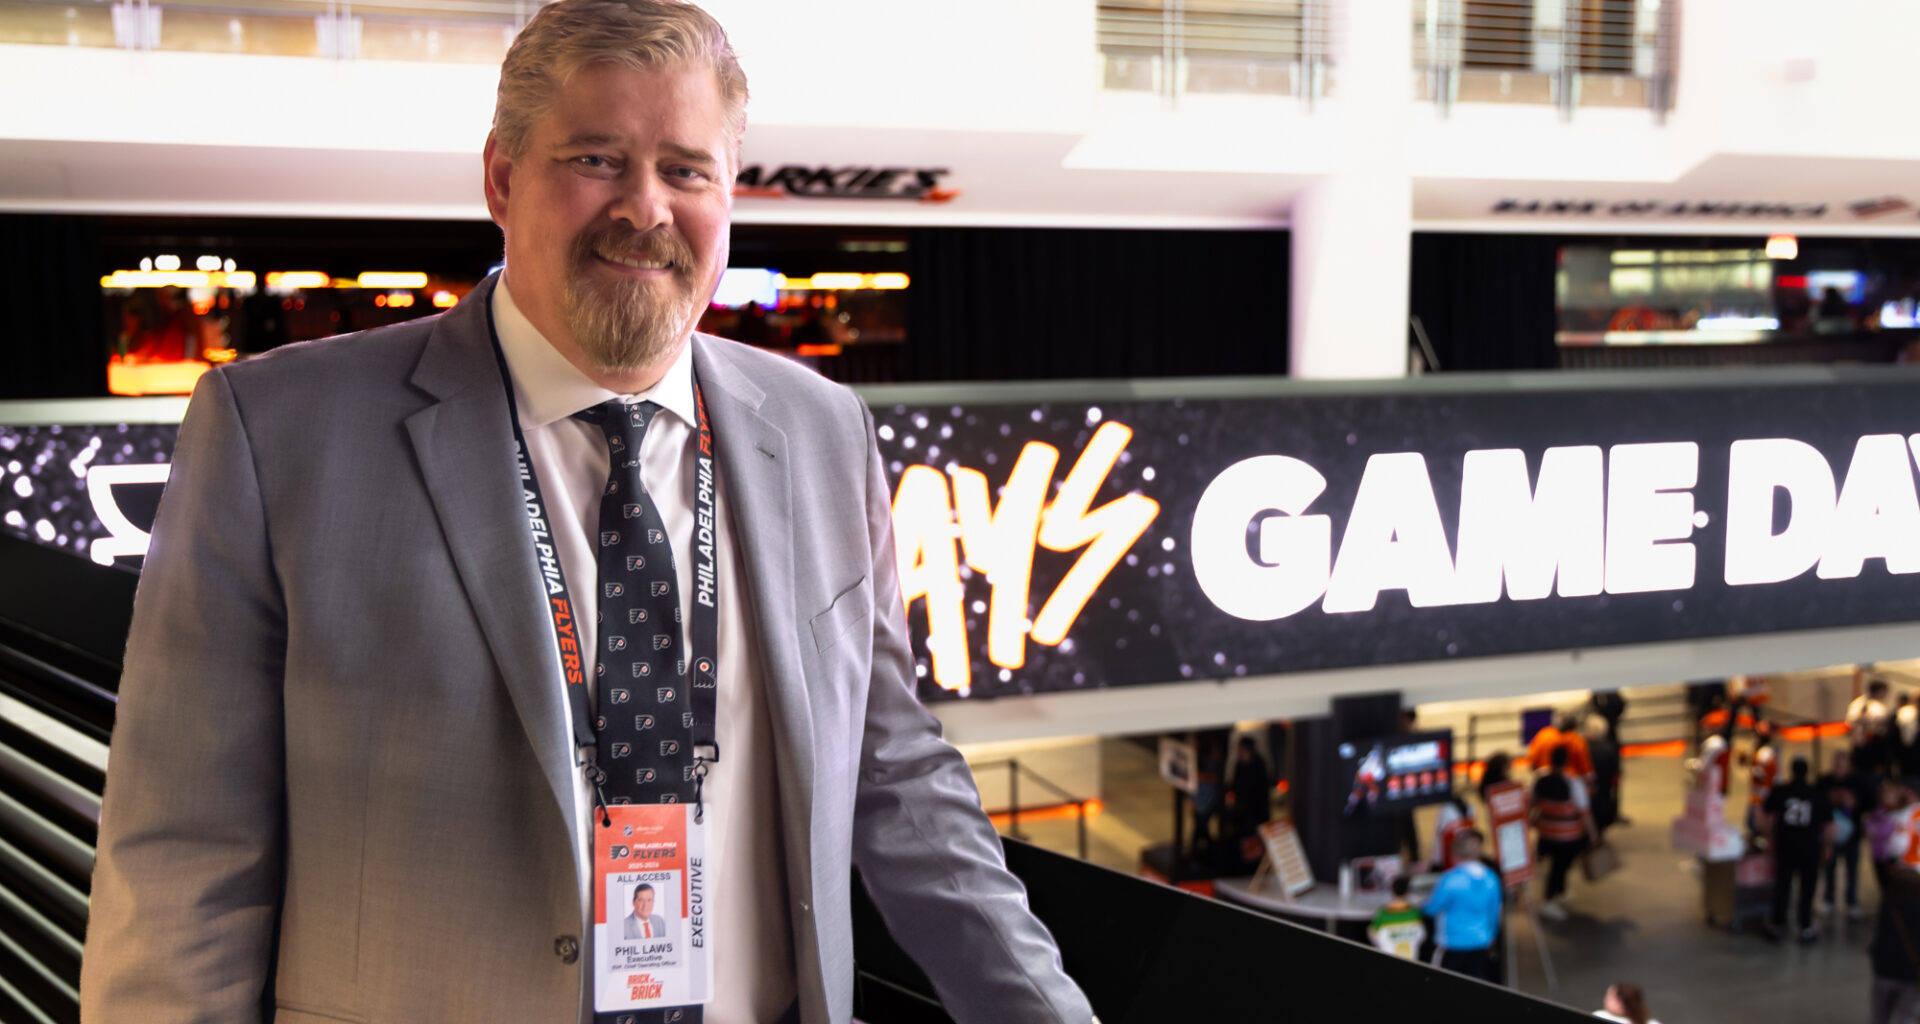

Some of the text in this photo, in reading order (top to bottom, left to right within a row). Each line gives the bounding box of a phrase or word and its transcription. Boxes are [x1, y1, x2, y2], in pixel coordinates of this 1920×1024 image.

[698, 457, 714, 608] PHILADELPHIA
[1191, 441, 1700, 621] GAME
[552, 598, 583, 684] FLYERS
[633, 849, 677, 859] FLYERS
[616, 872, 671, 883] ALL ACCESS
[691, 857, 704, 948] EXECUTIVE
[615, 943, 673, 956] PHIL LAWS
[627, 955, 663, 963] Executive
[631, 984, 663, 1000] BRICK
